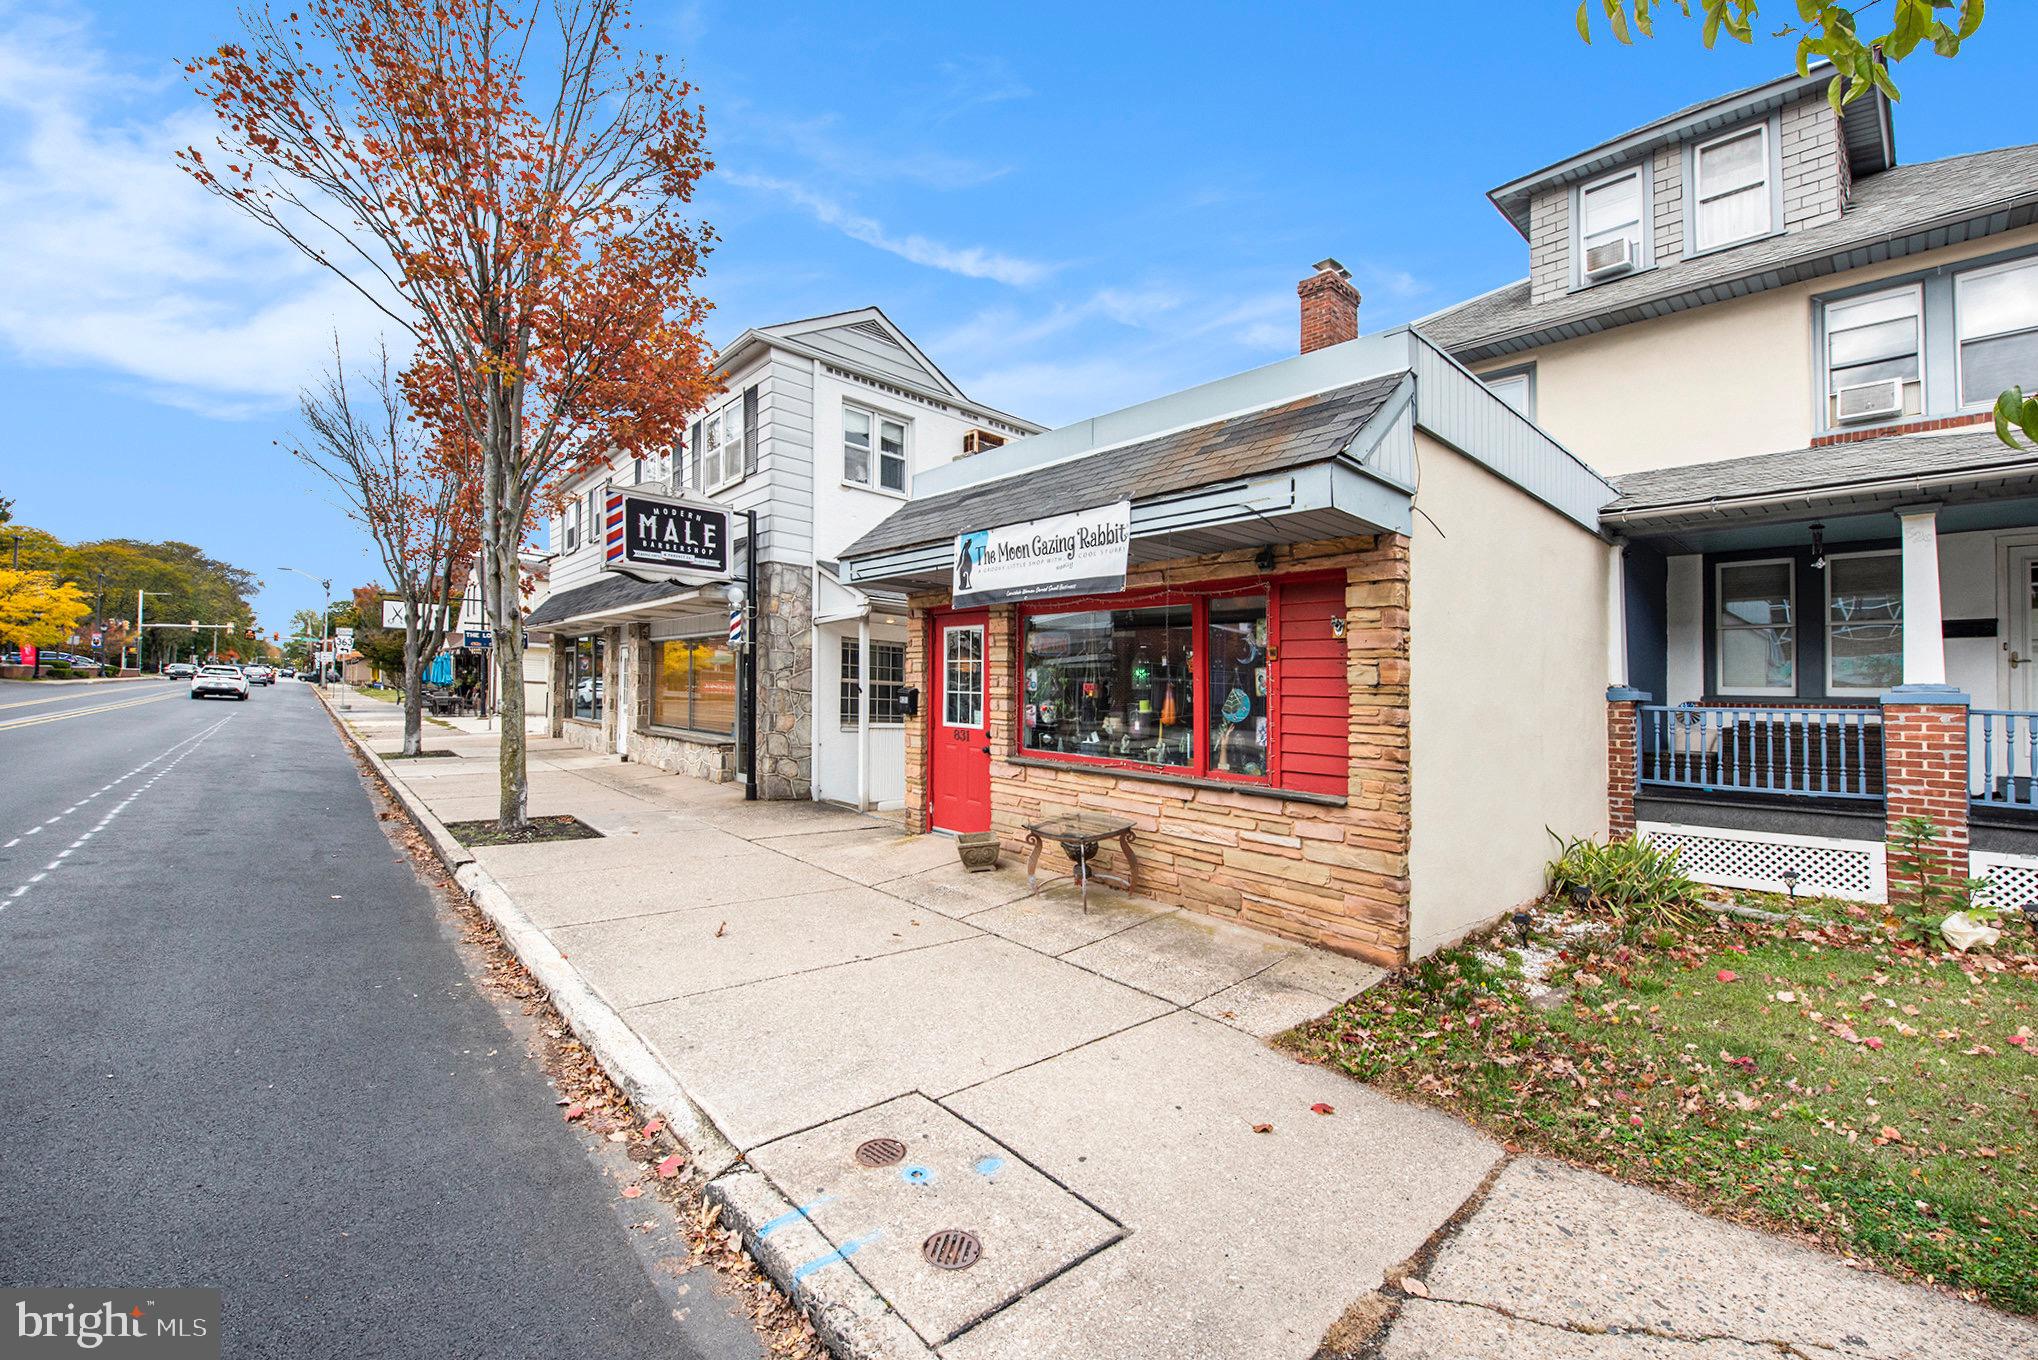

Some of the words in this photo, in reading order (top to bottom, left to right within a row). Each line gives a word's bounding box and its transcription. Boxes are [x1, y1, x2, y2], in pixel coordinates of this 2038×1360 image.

[653, 508, 702, 522] MODERN
[638, 513, 717, 548] MALE
[642, 540, 713, 556] BARBERSHOP
[975, 545, 997, 566] The
[998, 541, 1030, 563] Moon
[1031, 534, 1076, 560] Gazing
[1077, 522, 1128, 549] Rabbit
[336, 637, 353, 646] 363
[953, 729, 970, 742] 831
